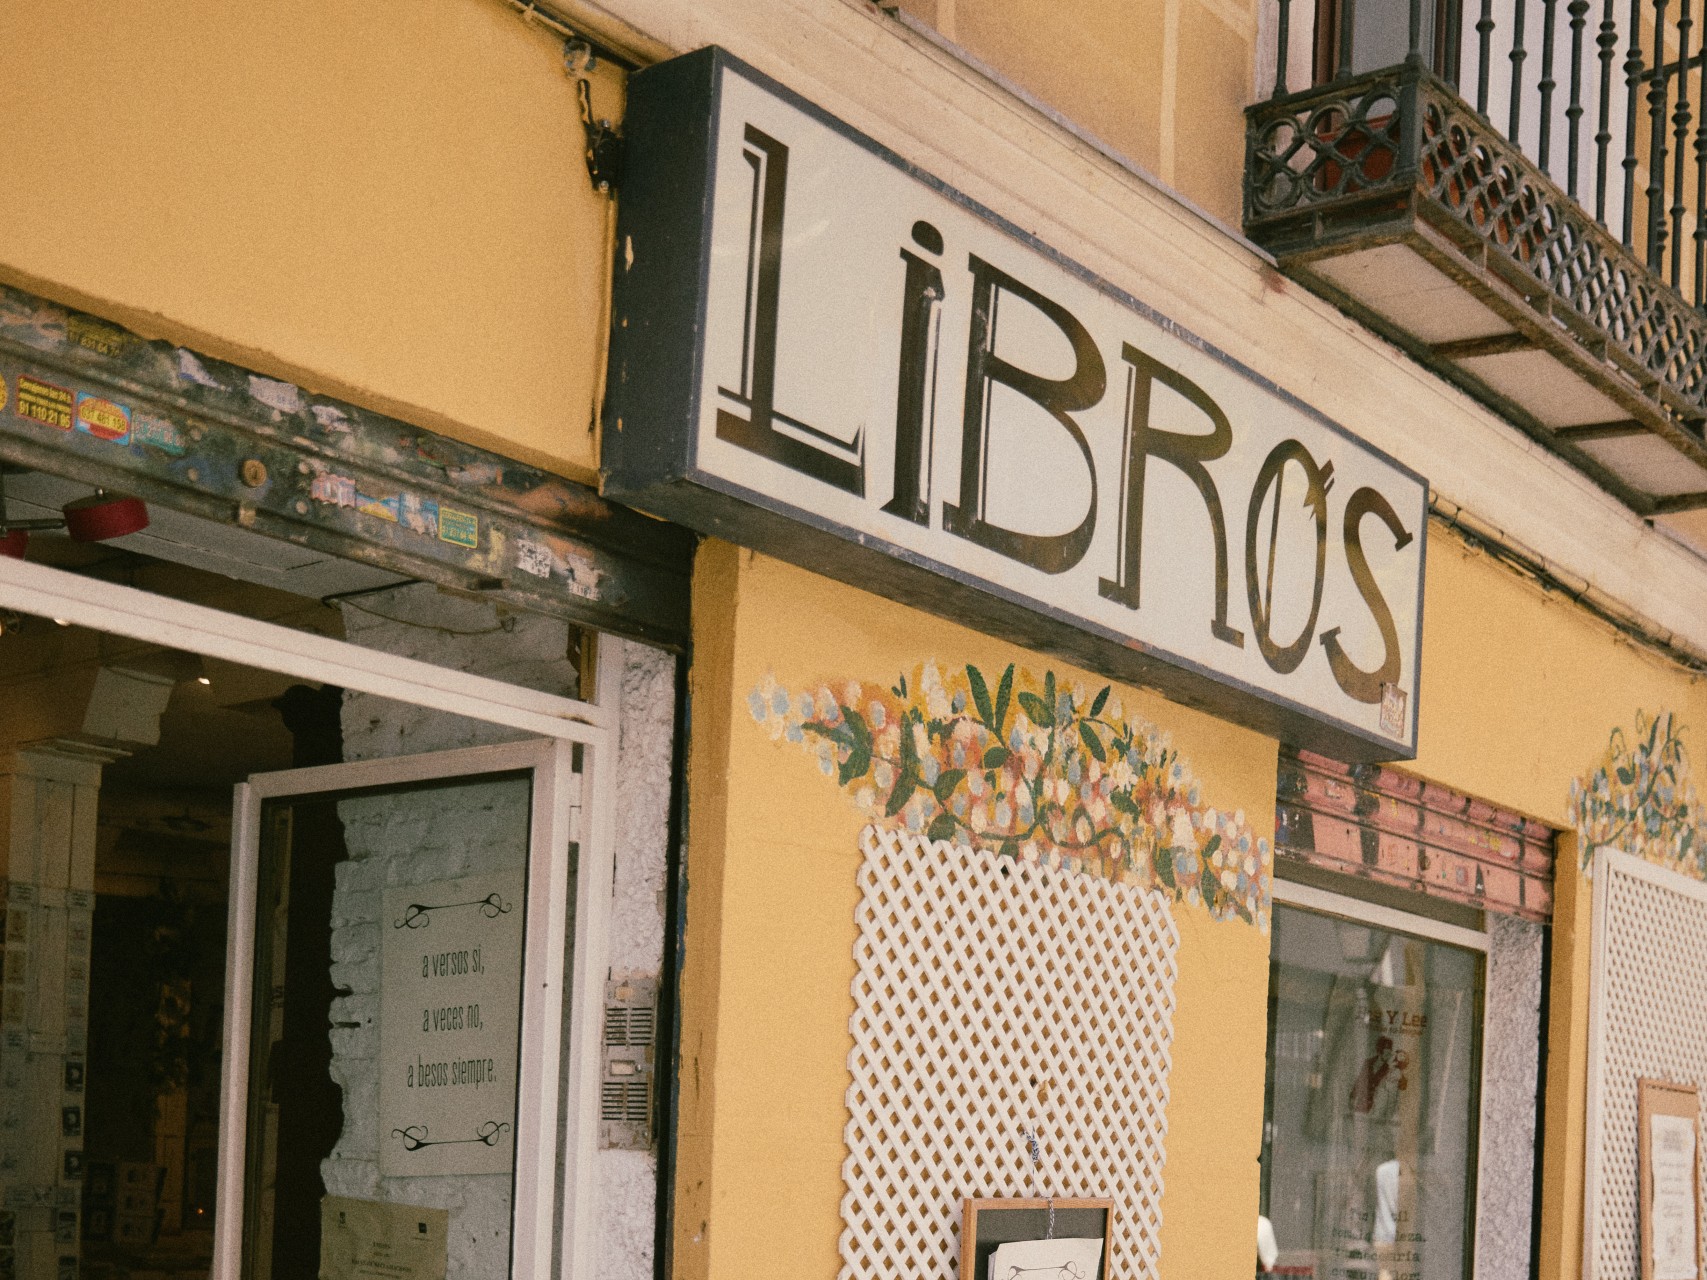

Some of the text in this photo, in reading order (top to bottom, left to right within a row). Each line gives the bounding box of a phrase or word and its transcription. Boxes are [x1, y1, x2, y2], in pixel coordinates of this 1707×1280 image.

[422, 954, 429, 978] a
[433, 950, 469, 976] versos
[423, 1003, 484, 1032] a veces no,
[407, 1054, 498, 1090] a besos siempre.
